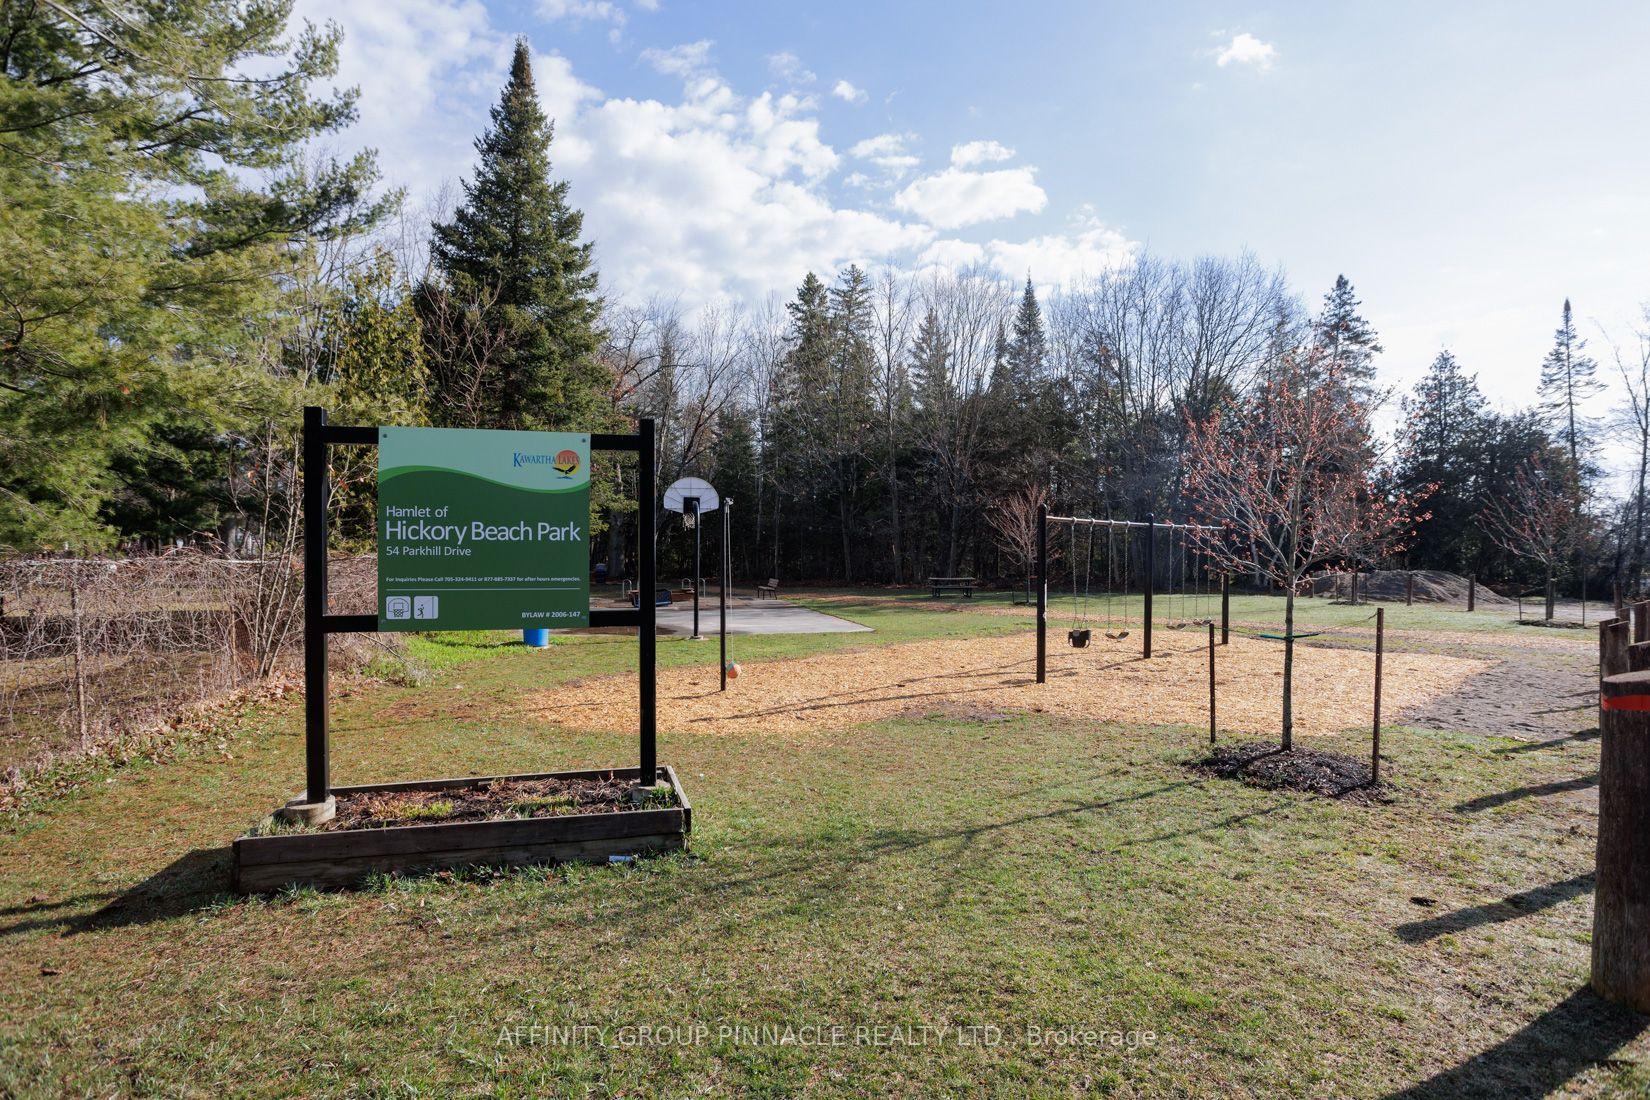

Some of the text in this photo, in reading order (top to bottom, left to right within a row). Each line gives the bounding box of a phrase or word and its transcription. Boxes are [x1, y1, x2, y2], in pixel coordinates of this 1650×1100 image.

[513, 453, 556, 467] KAWARTHA
[386, 506, 449, 517] Hamlet of
[386, 520, 581, 545] Hickory Beach Park
[386, 546, 472, 556] 54 Parkhill Drive
